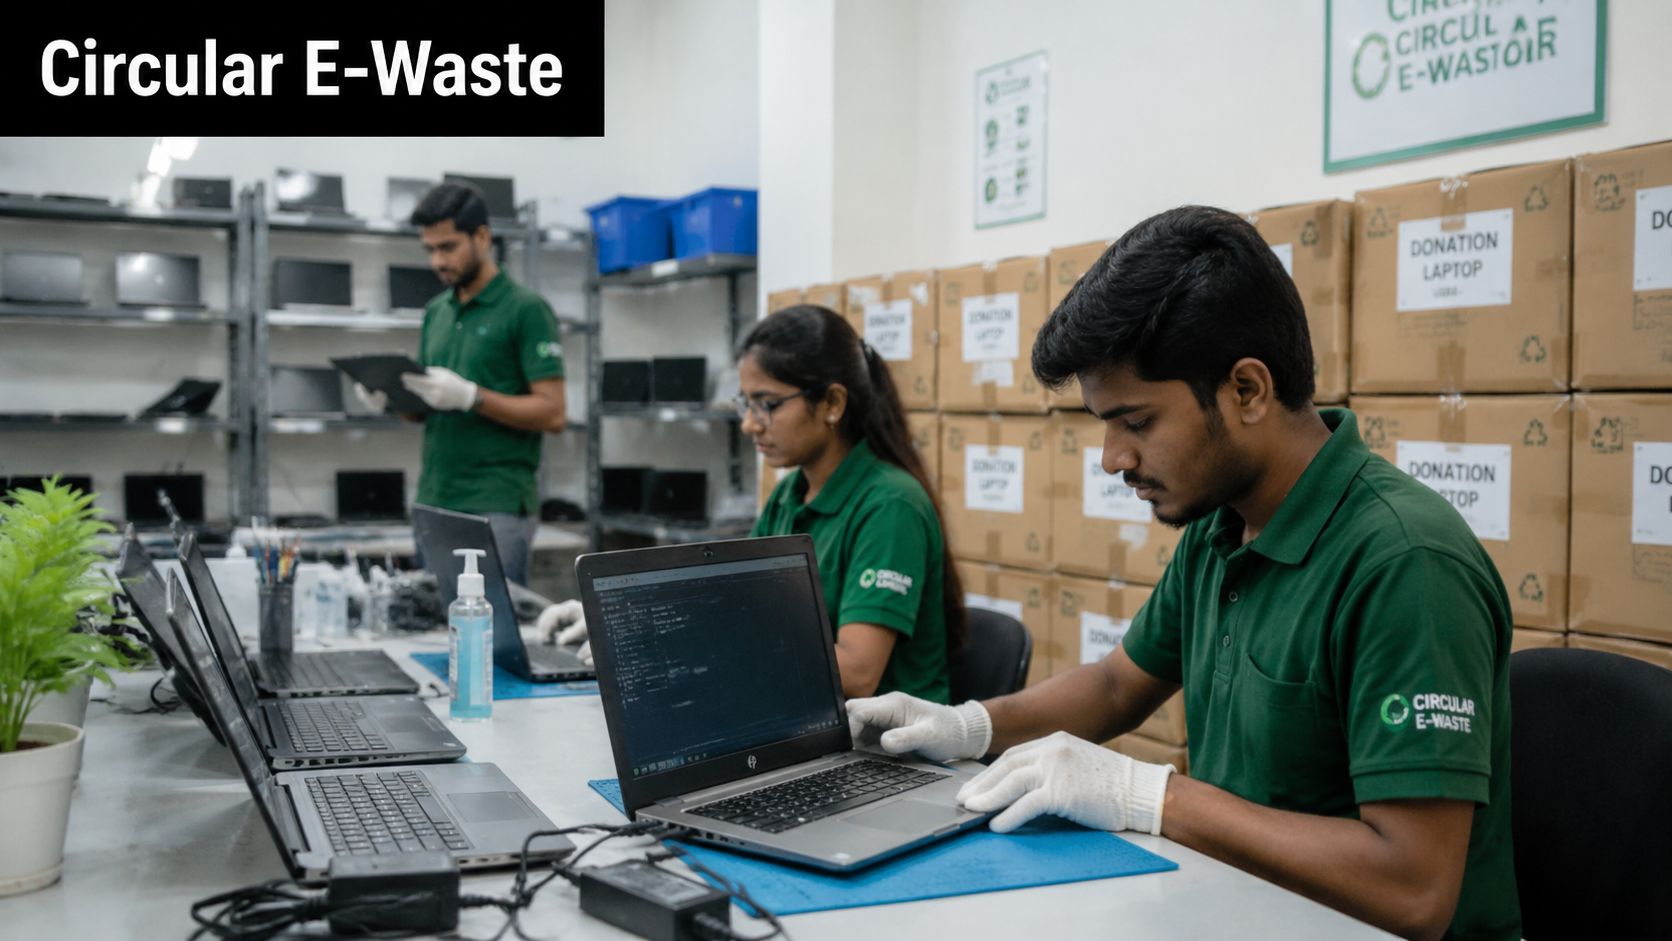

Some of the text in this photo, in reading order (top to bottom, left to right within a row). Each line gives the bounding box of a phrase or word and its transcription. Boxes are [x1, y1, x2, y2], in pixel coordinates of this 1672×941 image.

[1411, 231, 1499, 258] DONATION
[1423, 259, 1483, 282] LAPTOP
[1409, 461, 1496, 483] DONATION
[1412, 693, 1476, 716] CIRCULAR
[1415, 713, 1472, 733] E-WASTE
